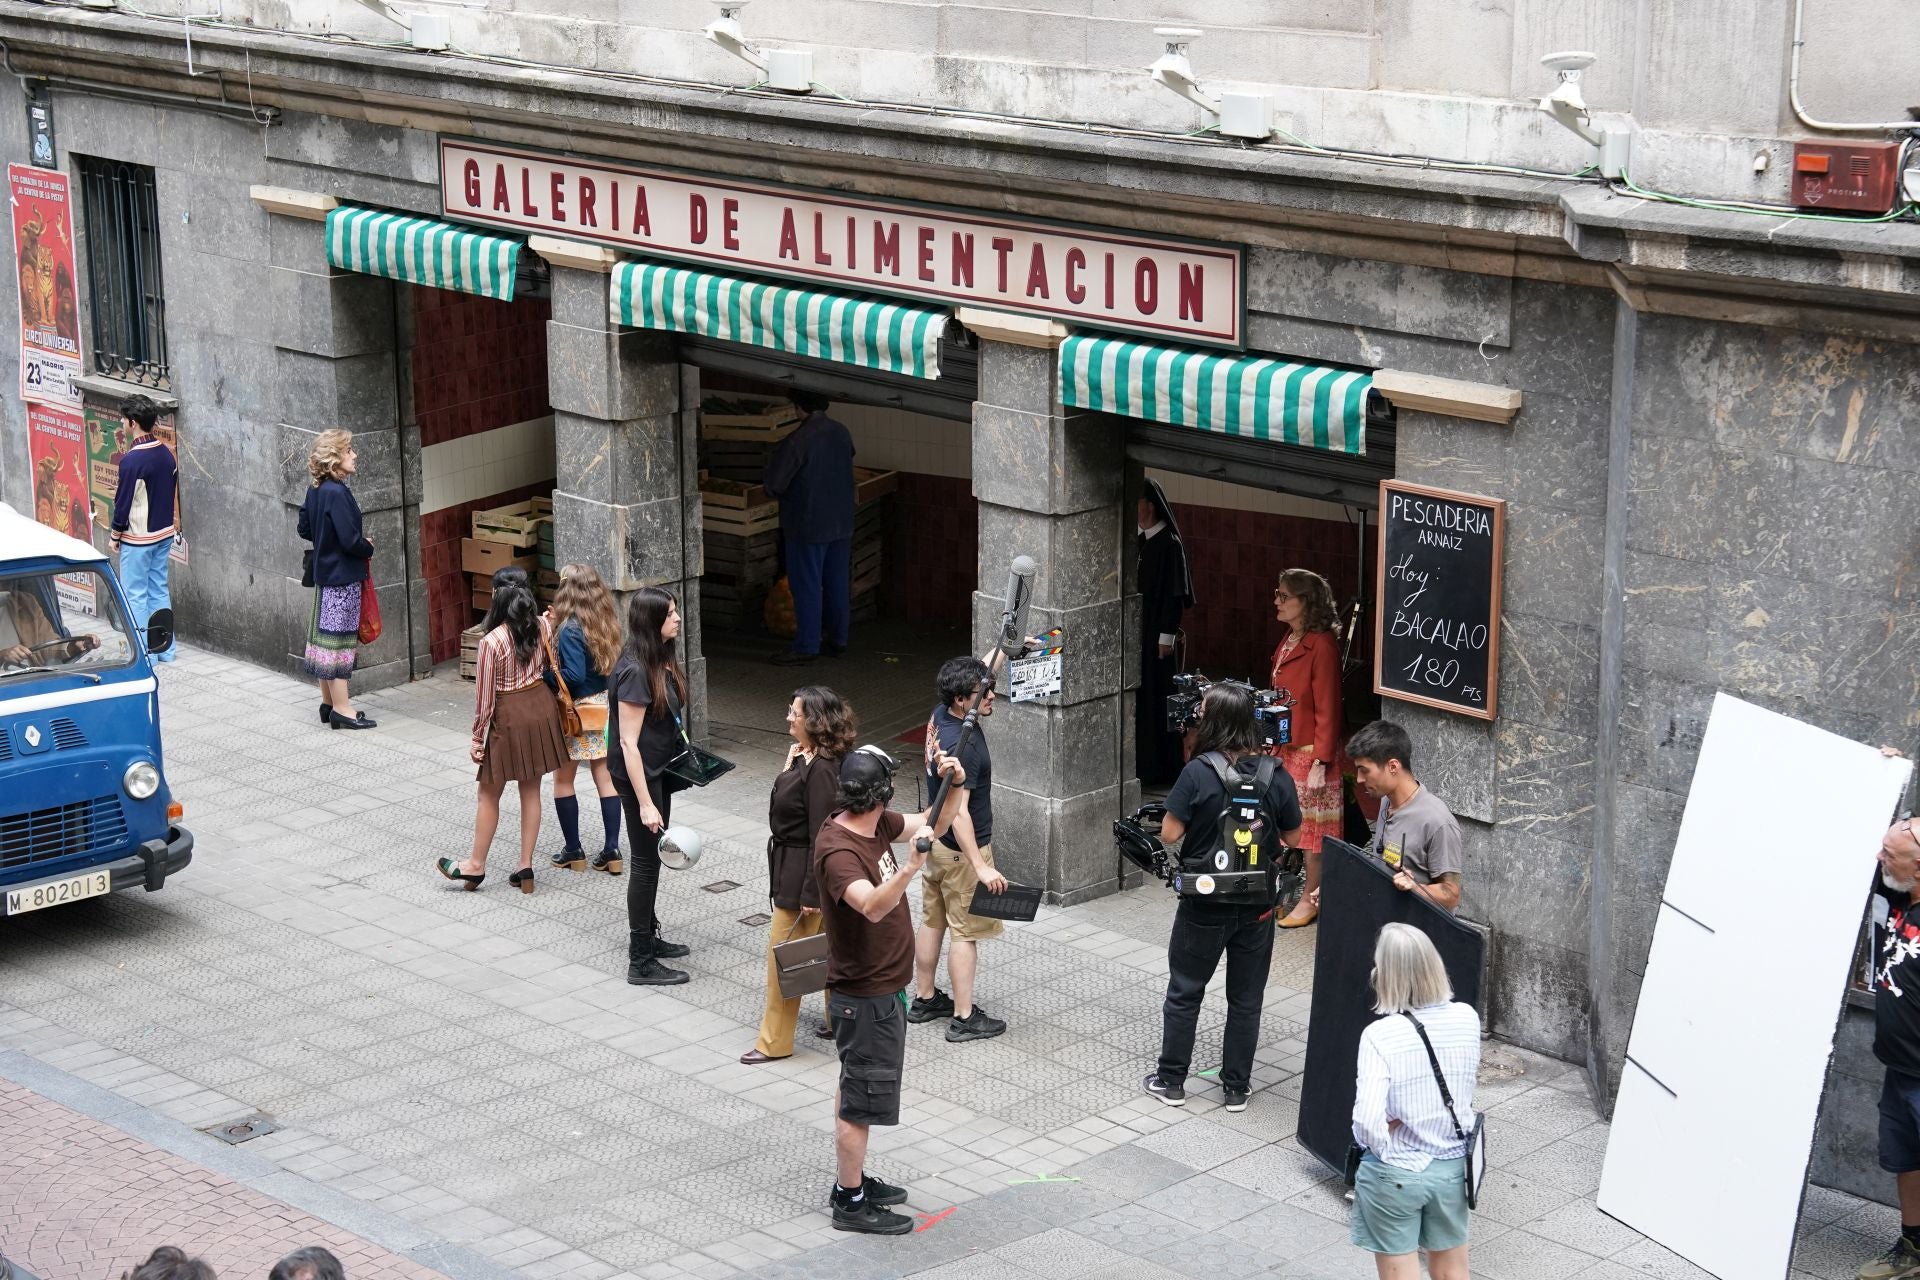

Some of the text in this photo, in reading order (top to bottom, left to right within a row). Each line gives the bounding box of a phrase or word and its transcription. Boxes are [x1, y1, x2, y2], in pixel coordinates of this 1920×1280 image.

[463, 157, 1205, 323] GALERIA DE ALIMENTACION
[24, 328, 78, 354] CIRCO UNIVERSAL
[26, 362, 42, 386] 23
[41, 359, 65, 371] MADRID
[56, 590, 79, 603] MADRID
[1390, 609, 1488, 651] BACALAO
[1402, 653, 1460, 688] 180
[1461, 685, 1483, 701] PTS
